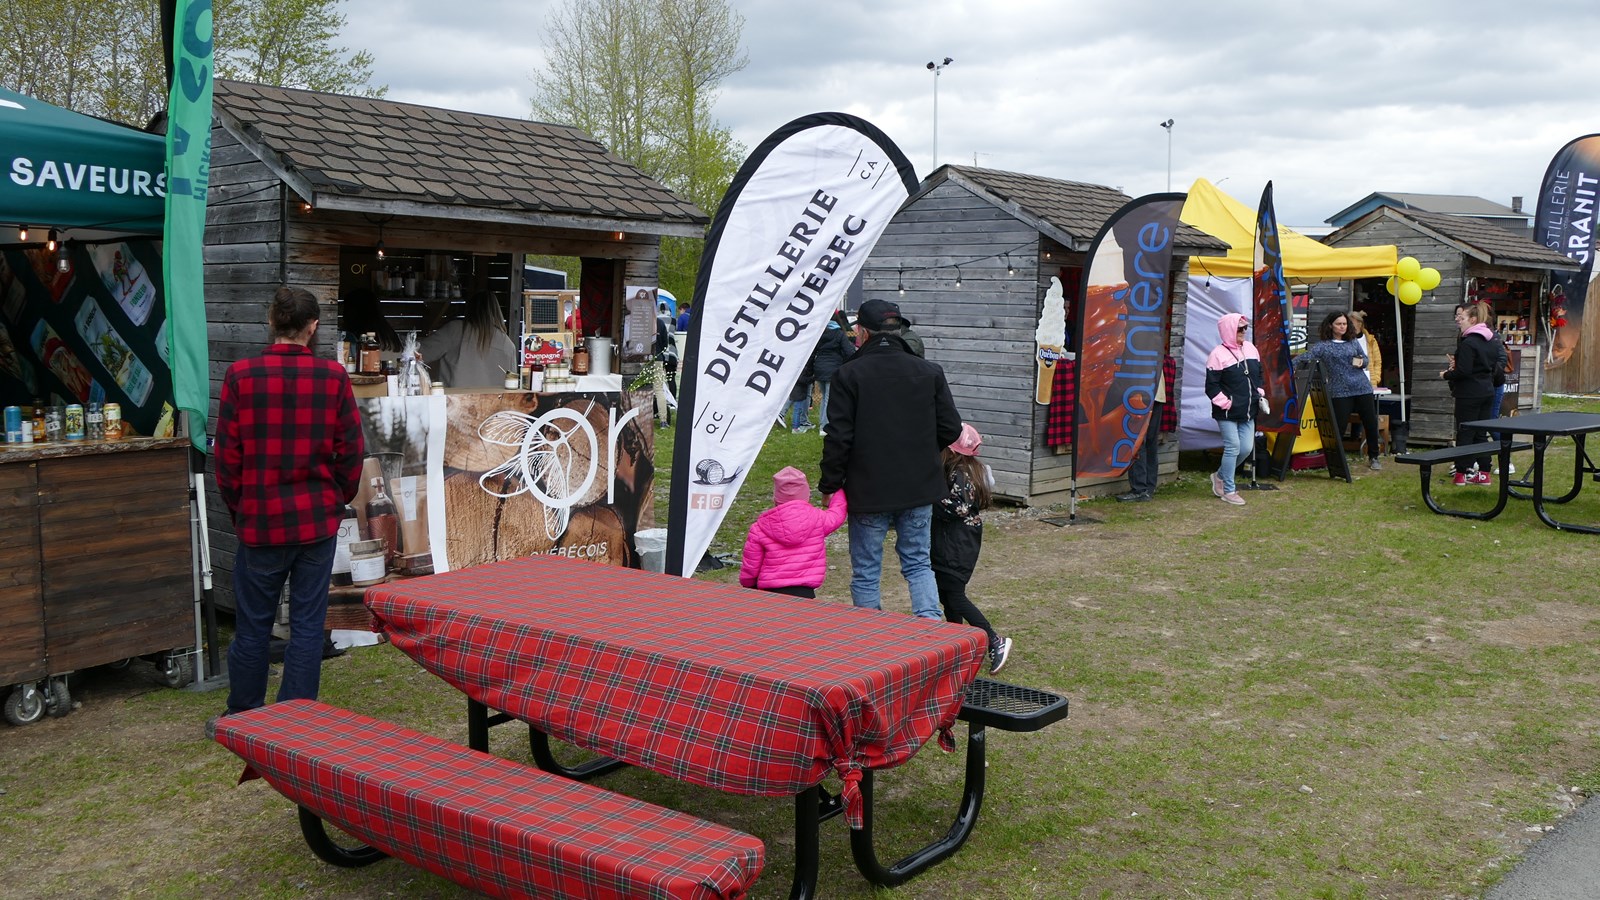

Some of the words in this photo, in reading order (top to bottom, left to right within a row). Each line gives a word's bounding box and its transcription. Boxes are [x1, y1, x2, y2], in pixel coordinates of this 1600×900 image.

[9, 157, 167, 198] SAVEURS
[861, 159, 878, 180] CA
[1546, 169, 1570, 251] STILLERIE
[1567, 172, 1599, 265] GRANIT
[704, 188, 838, 385] DISTILLERIE
[745, 349, 785, 397] DE
[775, 214, 868, 343] QUÉBEC
[525, 352, 561, 360] Champagne
[705, 410, 724, 435] QC
[530, 541, 608, 558] ÉBÉCOIS
